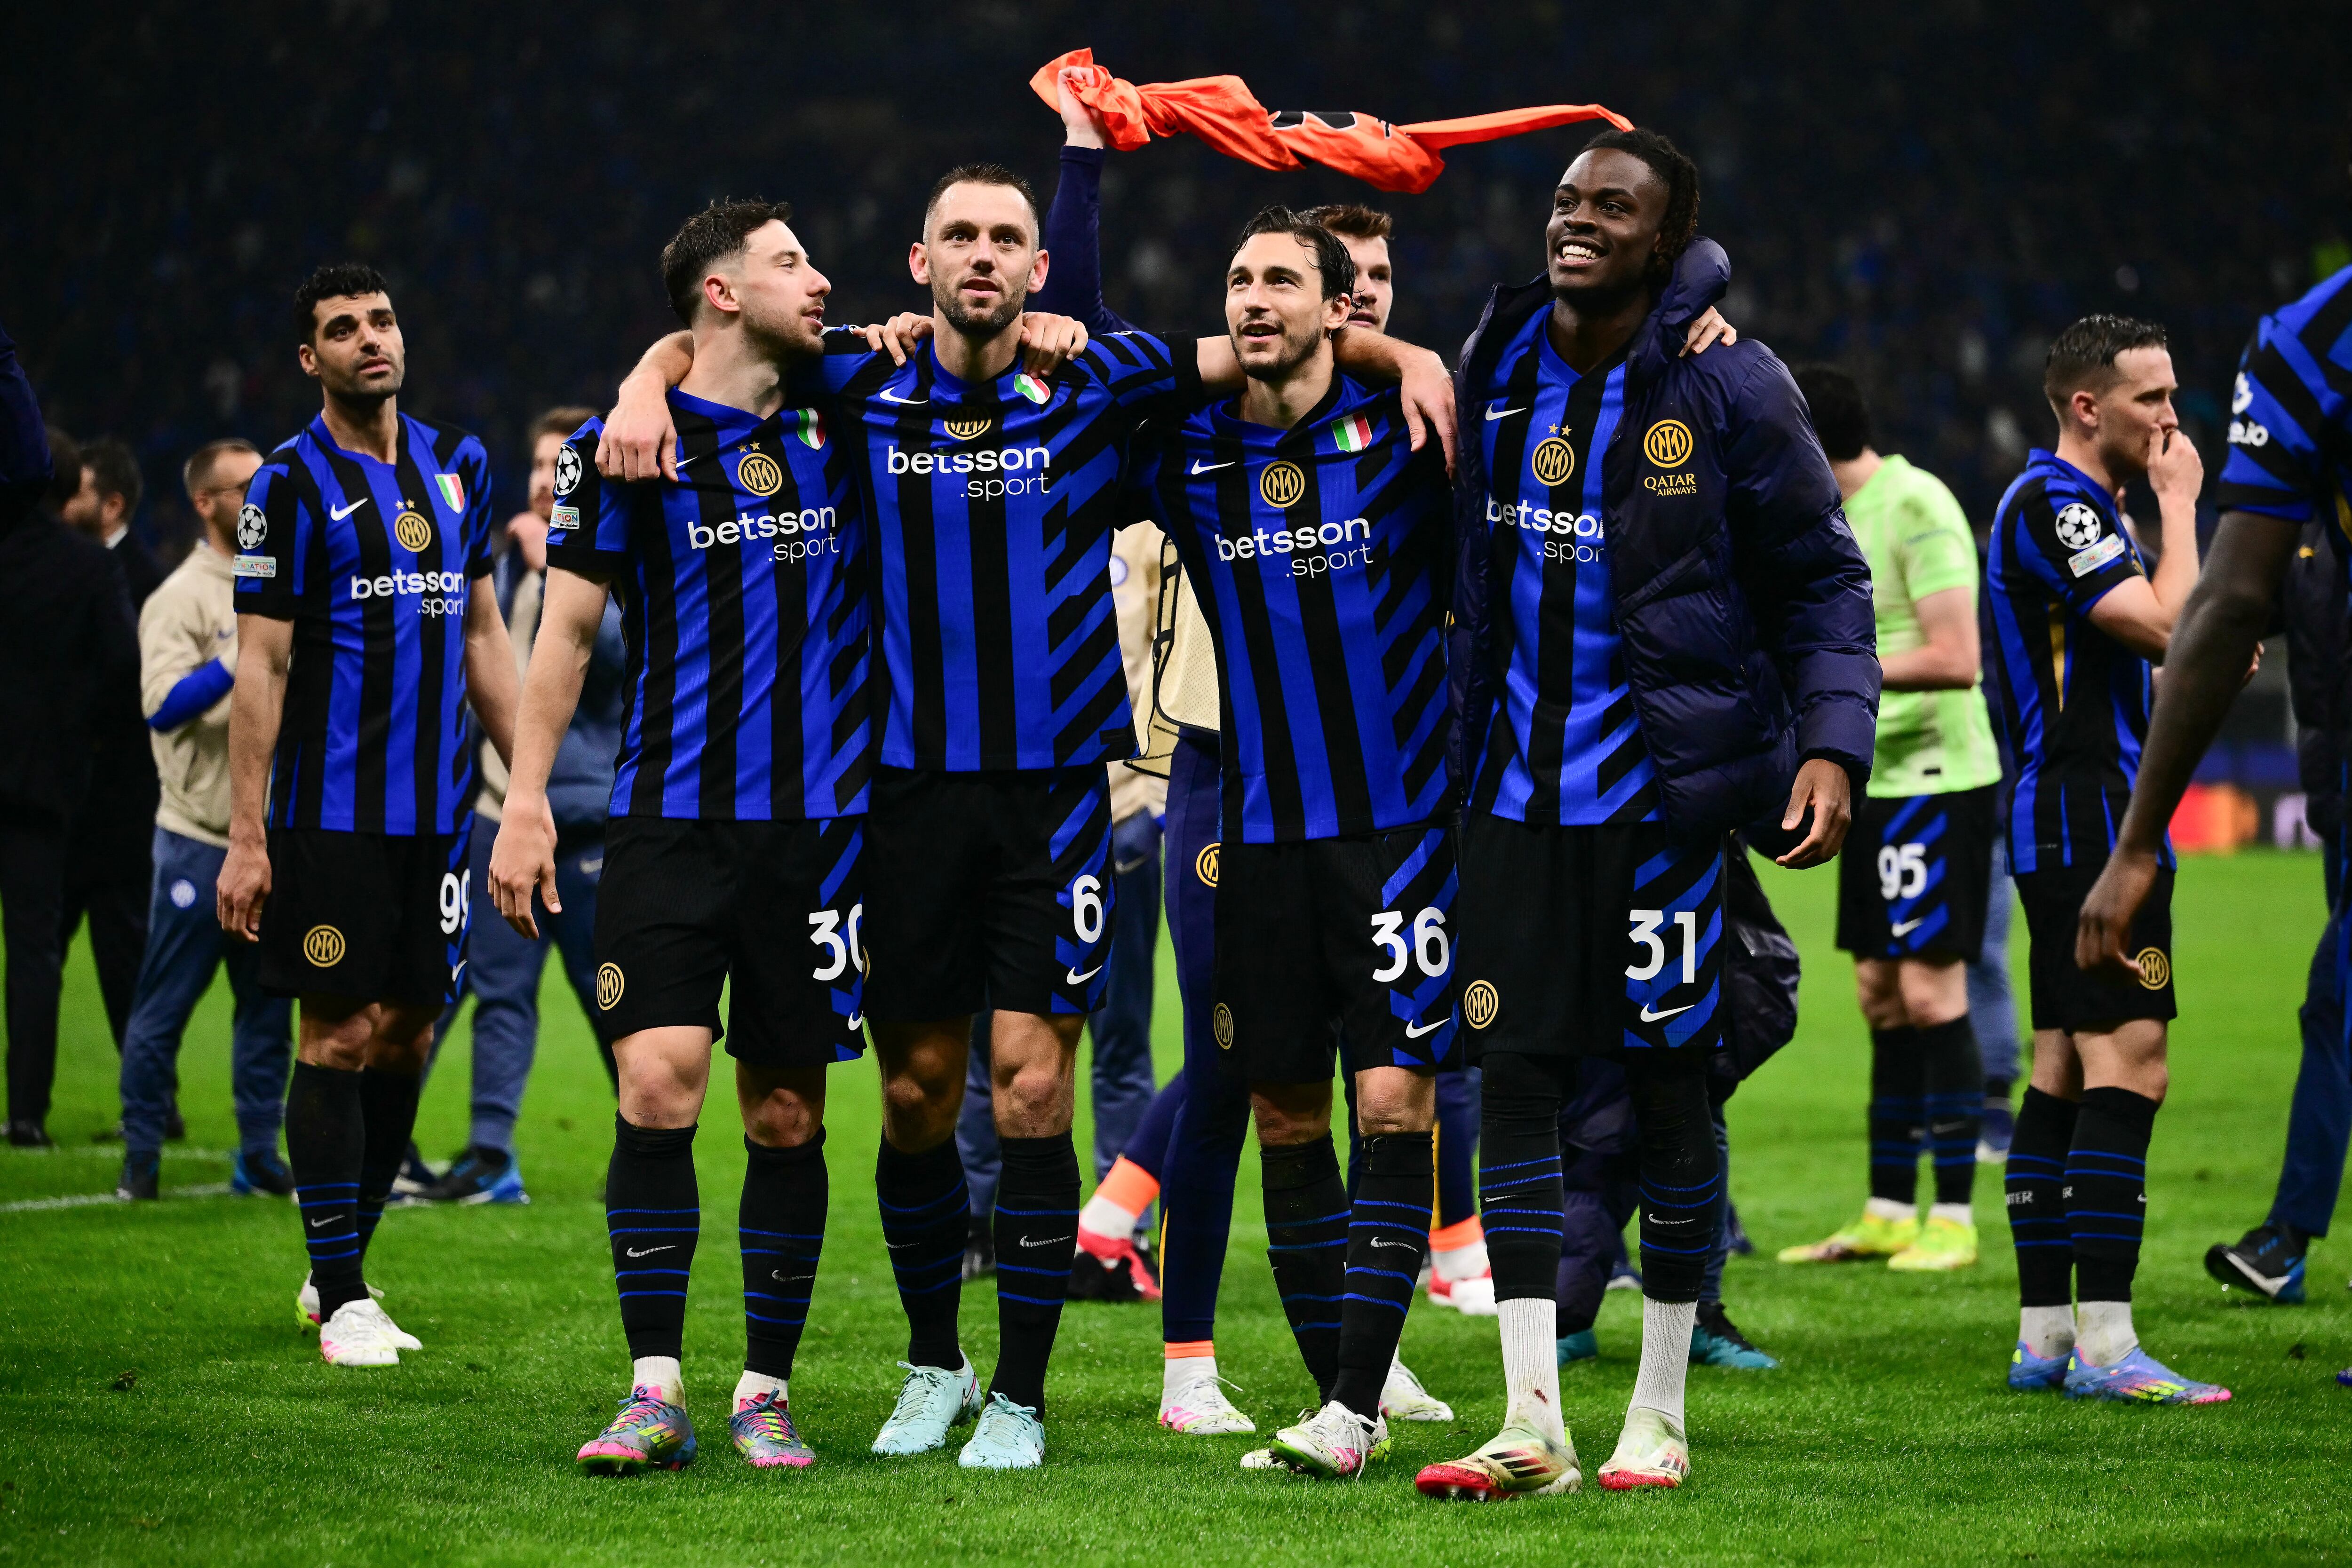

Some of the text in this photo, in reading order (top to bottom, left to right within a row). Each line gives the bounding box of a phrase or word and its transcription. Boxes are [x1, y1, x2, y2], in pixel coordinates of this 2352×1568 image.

[888, 445, 1050, 474] betsson
[961, 472, 1050, 501] .sport
[1644, 473, 1696, 491] QATAR
[1657, 486, 1697, 497] AIRWAYS
[687, 506, 835, 549] betsson
[1215, 518, 1371, 562] betsson
[768, 532, 839, 563] .sport
[1286, 543, 1374, 578] .sport
[1536, 541, 1604, 564] .spor
[351, 568, 464, 599] betsson
[1877, 842, 1928, 900] 95
[439, 868, 470, 934] 99
[1073, 874, 1103, 943] 6
[1371, 907, 1449, 982] 36
[1625, 910, 1695, 983] 31
